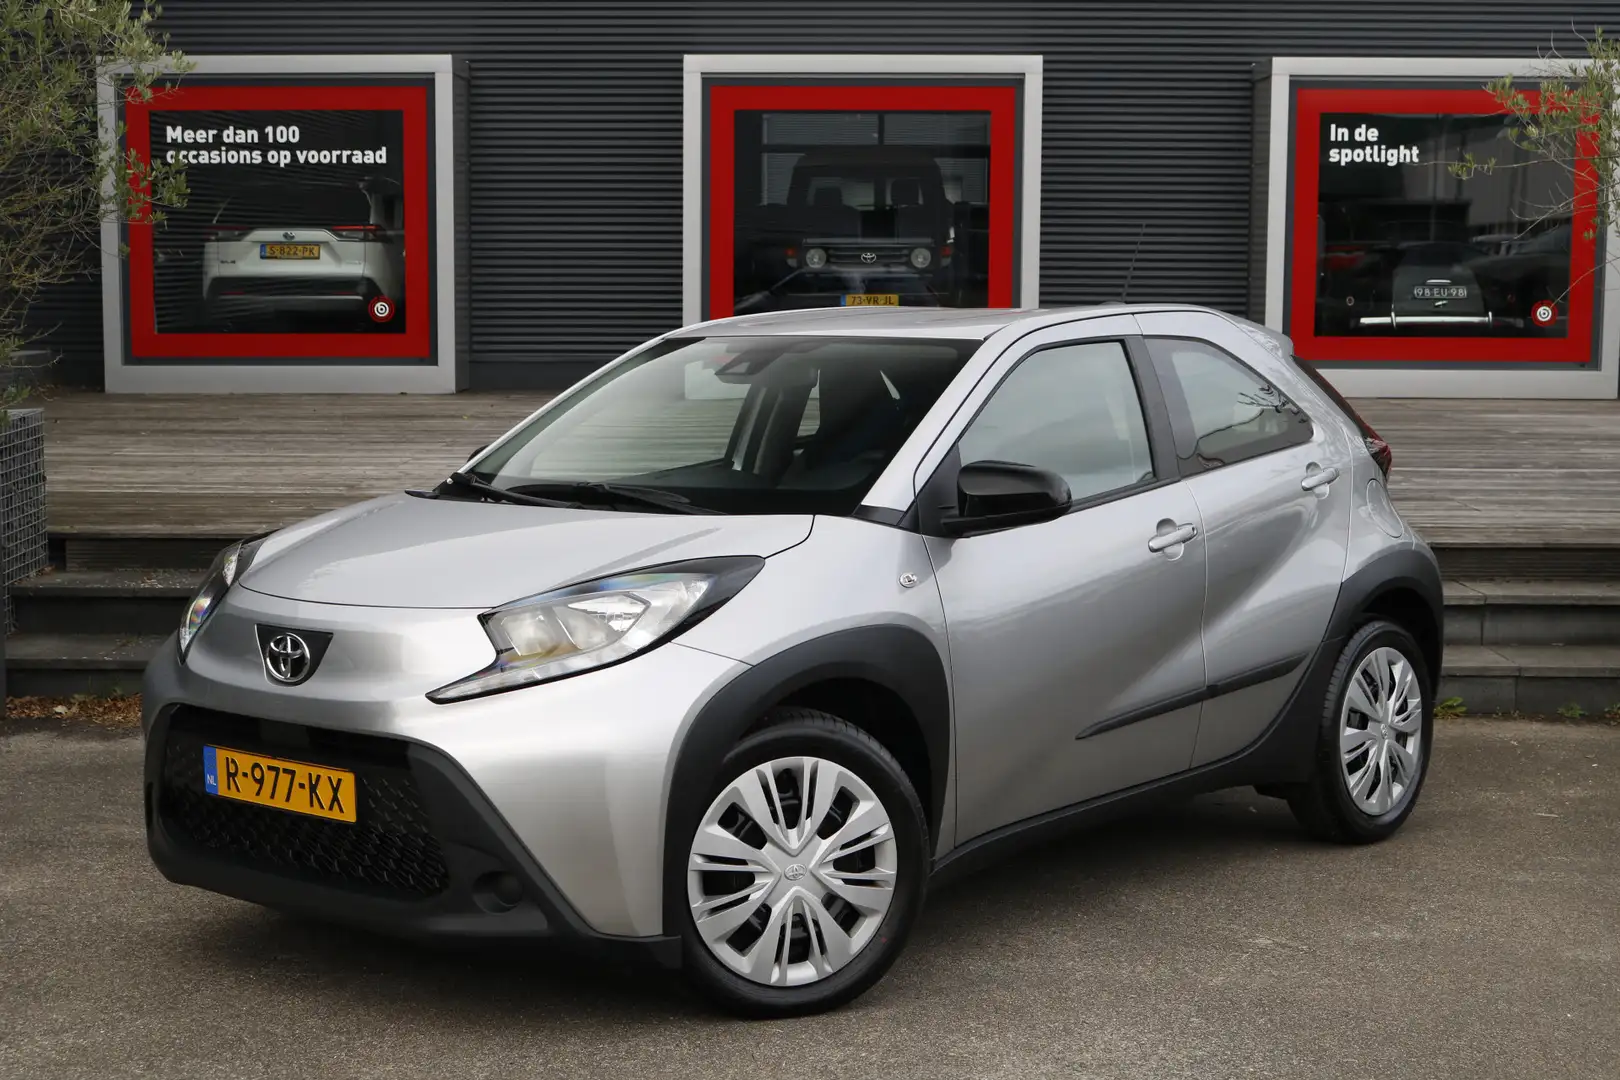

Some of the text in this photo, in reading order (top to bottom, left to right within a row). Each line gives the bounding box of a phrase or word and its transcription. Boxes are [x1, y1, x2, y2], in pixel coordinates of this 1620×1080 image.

[166, 125, 300, 144] Meer dan 100
[1330, 124, 1379, 141] In de
[166, 146, 387, 168] occasions op voorraad
[1329, 145, 1419, 166] spotlight
[207, 774, 216, 785] NL
[225, 756, 344, 813] R-977-KX
